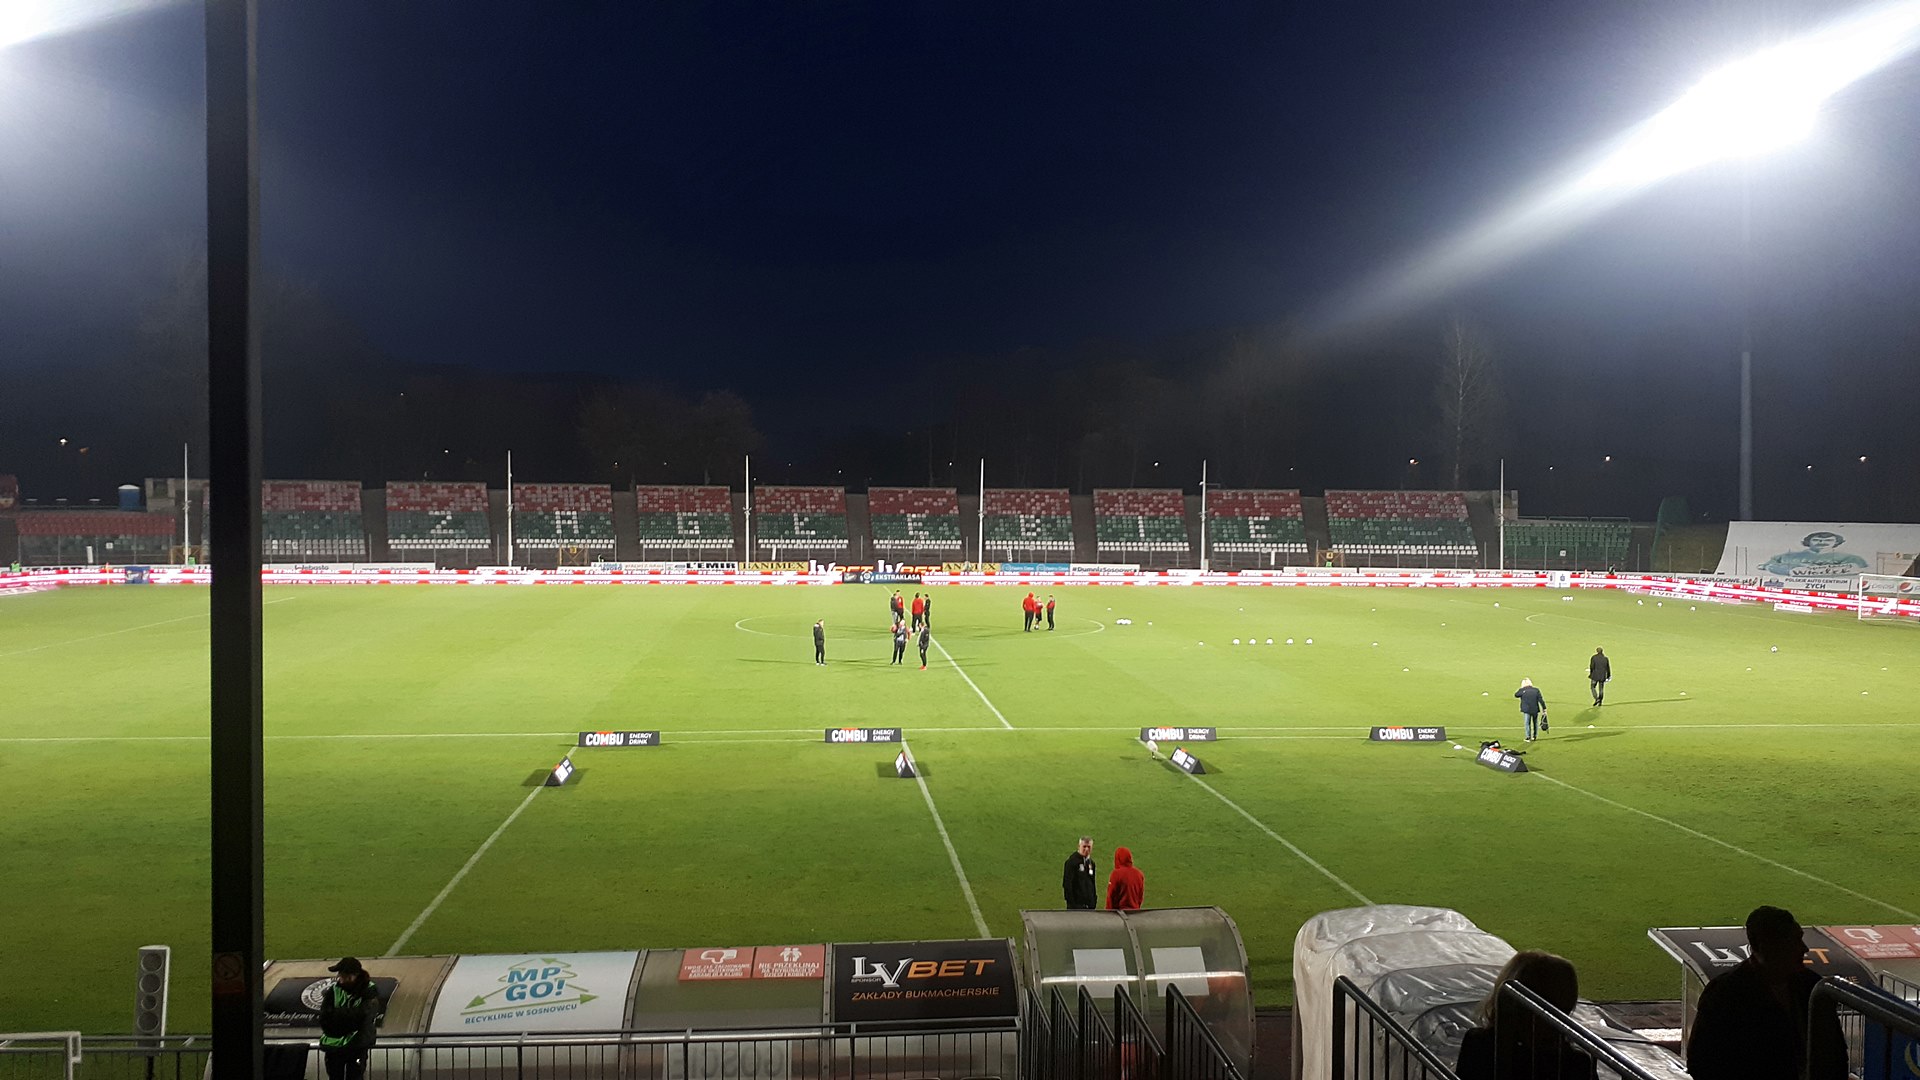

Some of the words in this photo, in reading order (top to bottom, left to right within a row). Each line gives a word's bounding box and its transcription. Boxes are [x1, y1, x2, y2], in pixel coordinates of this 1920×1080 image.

[585, 733, 624, 746] COMBU
[831, 729, 868, 742] COMBU
[1148, 728, 1185, 740] COMBU
[1379, 728, 1414, 740] COMBU
[507, 966, 561, 983] MP
[851, 956, 996, 988] LVBET
[505, 979, 566, 1002] GO!
[851, 990, 903, 1001] ZAKŁADY
[905, 986, 1000, 999] BUKMACHERSKIE
[464, 1010, 513, 1025] RECYKLING
[515, 1010, 525, 1018] W
[526, 1003, 578, 1016] SOSNOWCU
